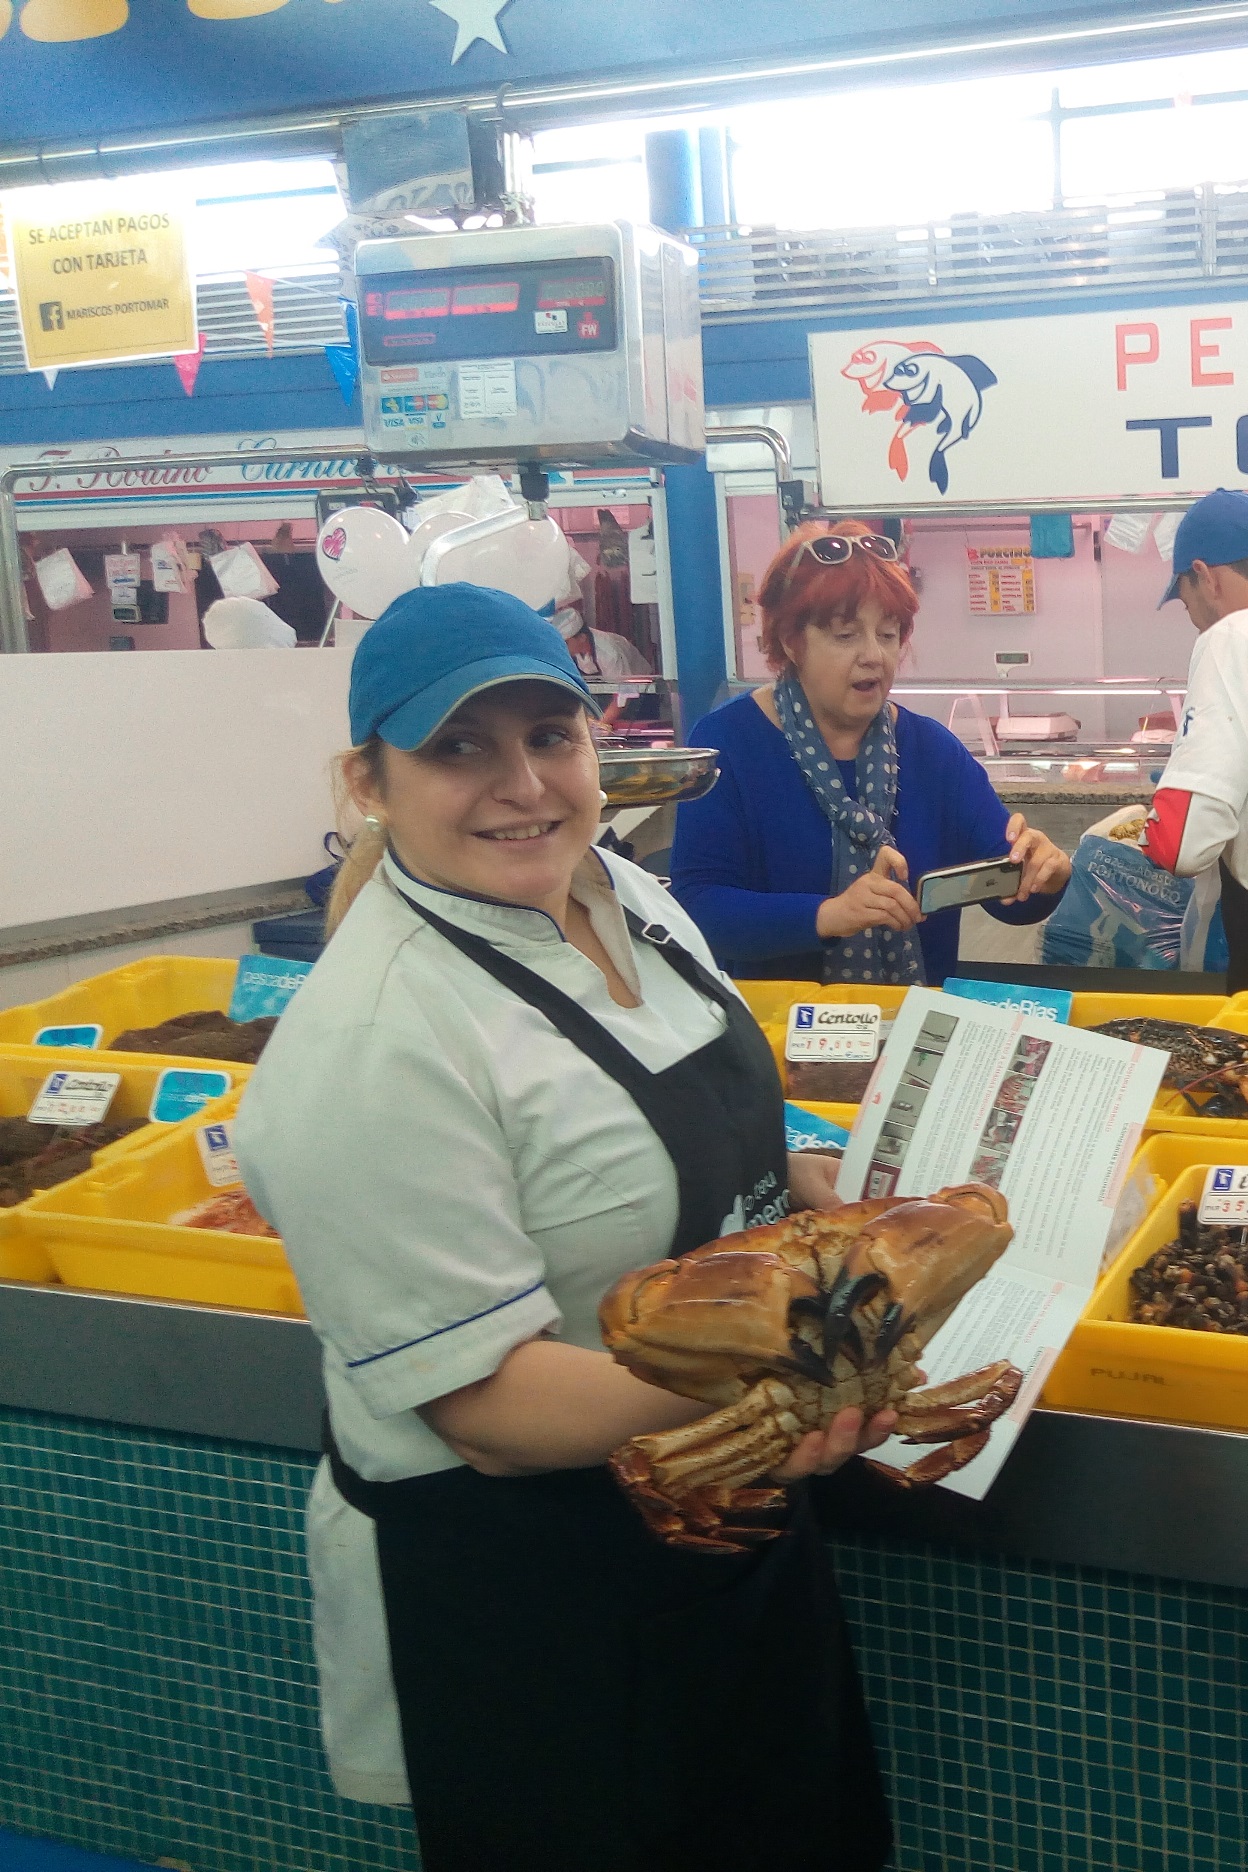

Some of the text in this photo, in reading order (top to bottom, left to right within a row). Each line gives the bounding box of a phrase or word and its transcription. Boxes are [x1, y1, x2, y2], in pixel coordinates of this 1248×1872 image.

[29, 213, 170, 245] SE ACEPTAN PAGOS
[53, 248, 148, 275] CON TARJETA
[66, 305, 114, 321] MARISCOS
[115, 298, 170, 315] PORTOMAR
[581, 324, 598, 336] FW
[1086, 860, 1182, 904] PORTONOVO
[817, 1011, 879, 1025] Centollo
